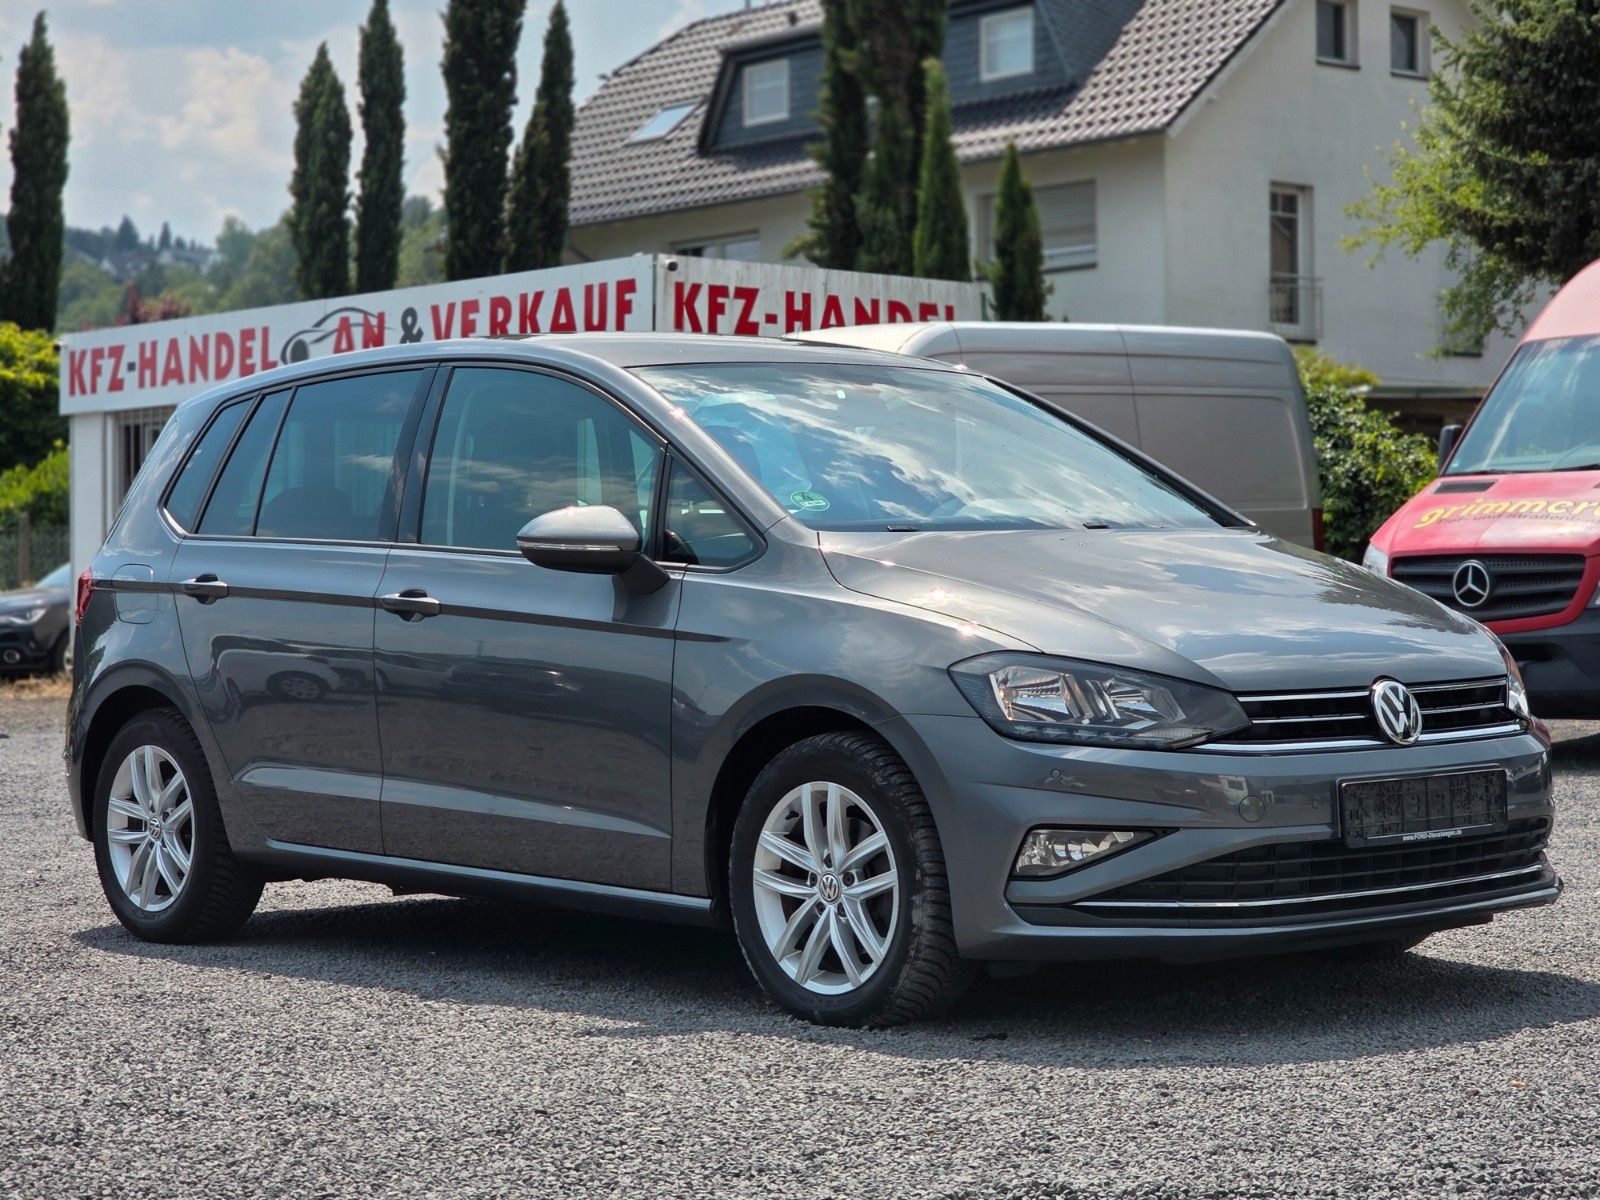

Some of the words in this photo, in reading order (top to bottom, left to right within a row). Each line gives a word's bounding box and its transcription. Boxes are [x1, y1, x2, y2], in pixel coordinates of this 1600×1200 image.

[68, 326, 278, 397] KFZ-HANDEL
[431, 278, 637, 340] VERKAUF
[1413, 498, 1600, 528] grimmer
